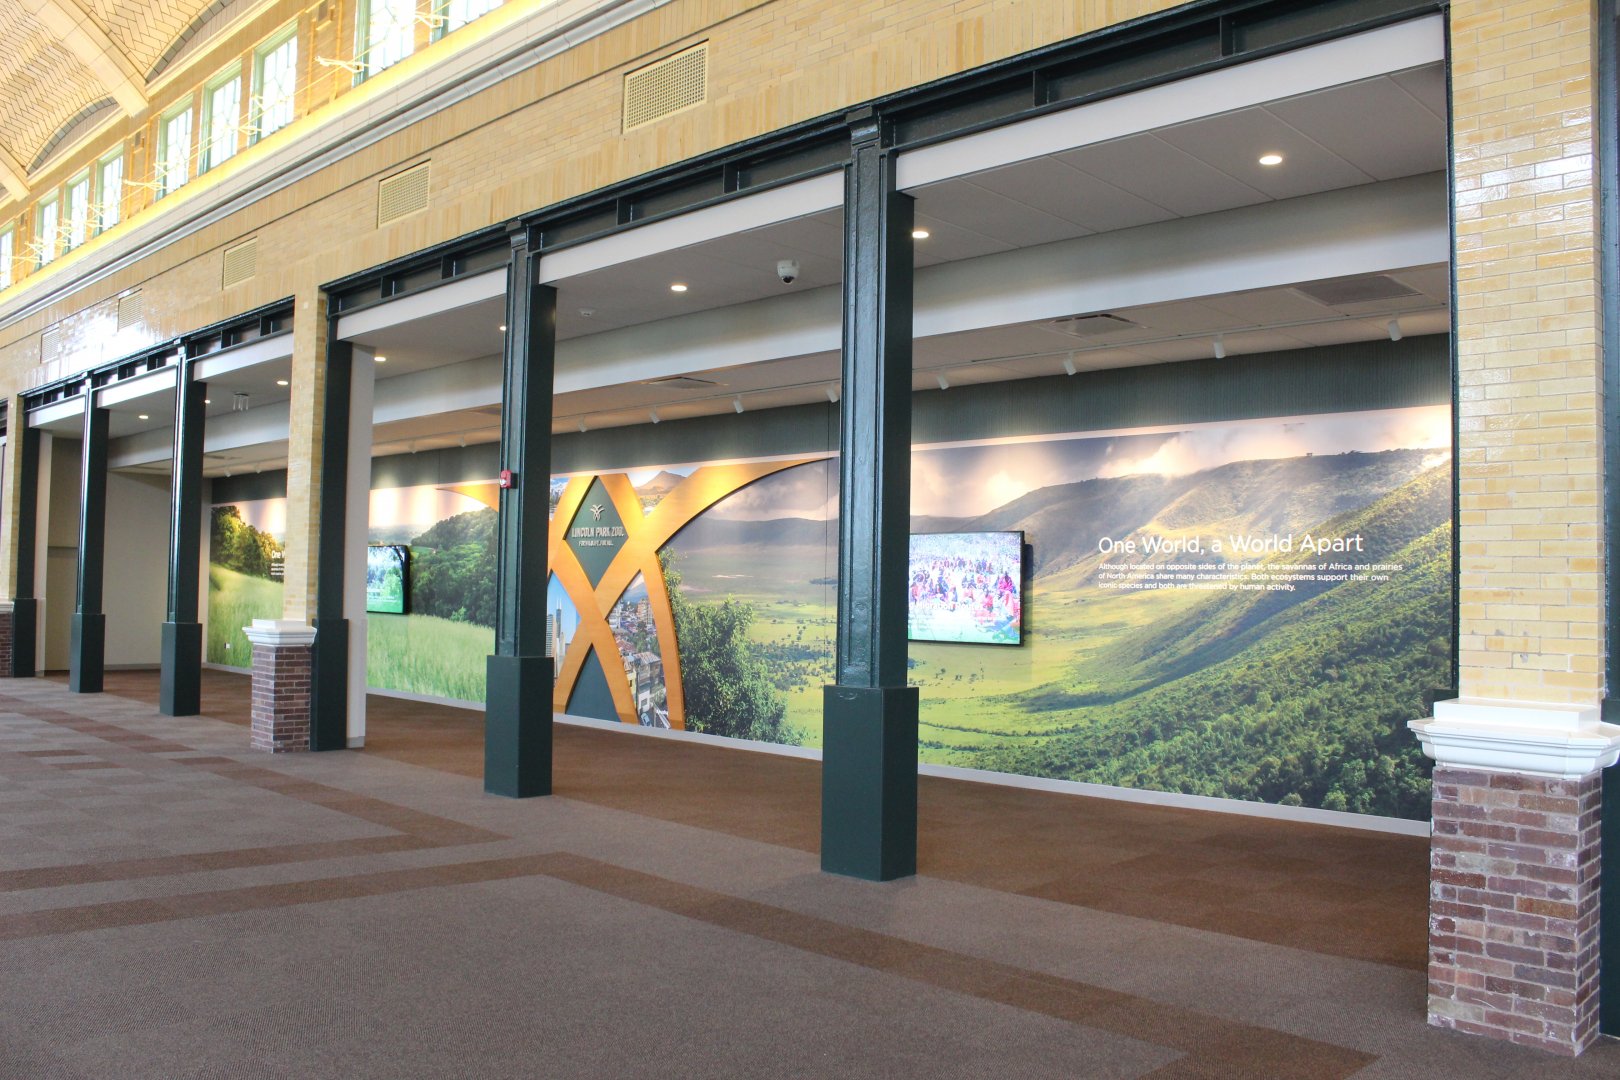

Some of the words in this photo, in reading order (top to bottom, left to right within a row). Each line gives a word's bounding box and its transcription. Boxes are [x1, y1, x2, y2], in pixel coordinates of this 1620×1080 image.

[571, 527, 594, 538] LINCOLN
[595, 527, 611, 537] PARK
[1098, 537, 1136, 554] One
[1142, 535, 1205, 556] World,
[1211, 540, 1222, 553] a
[1229, 534, 1292, 553] World
[1300, 533, 1364, 556] Apart
[1098, 563, 1128, 571] Although
[1166, 563, 1197, 571] opposite
[1240, 563, 1266, 571] planet,
[1267, 563, 1280, 571] the
[1281, 563, 1317, 571] savannas
[1318, 563, 1328, 571] of
[1328, 563, 1353, 571] Africa
[1354, 563, 1370, 571] and
[1371, 563, 1403, 572] prairies
[1250, 573, 1270, 581] Both
[1270, 574, 1316, 582] ecosystems
[1316, 574, 1349, 582] support
[1188, 582, 1228, 590] threatened
[1229, 583, 1239, 591] by
[1266, 583, 1296, 592] activity.
